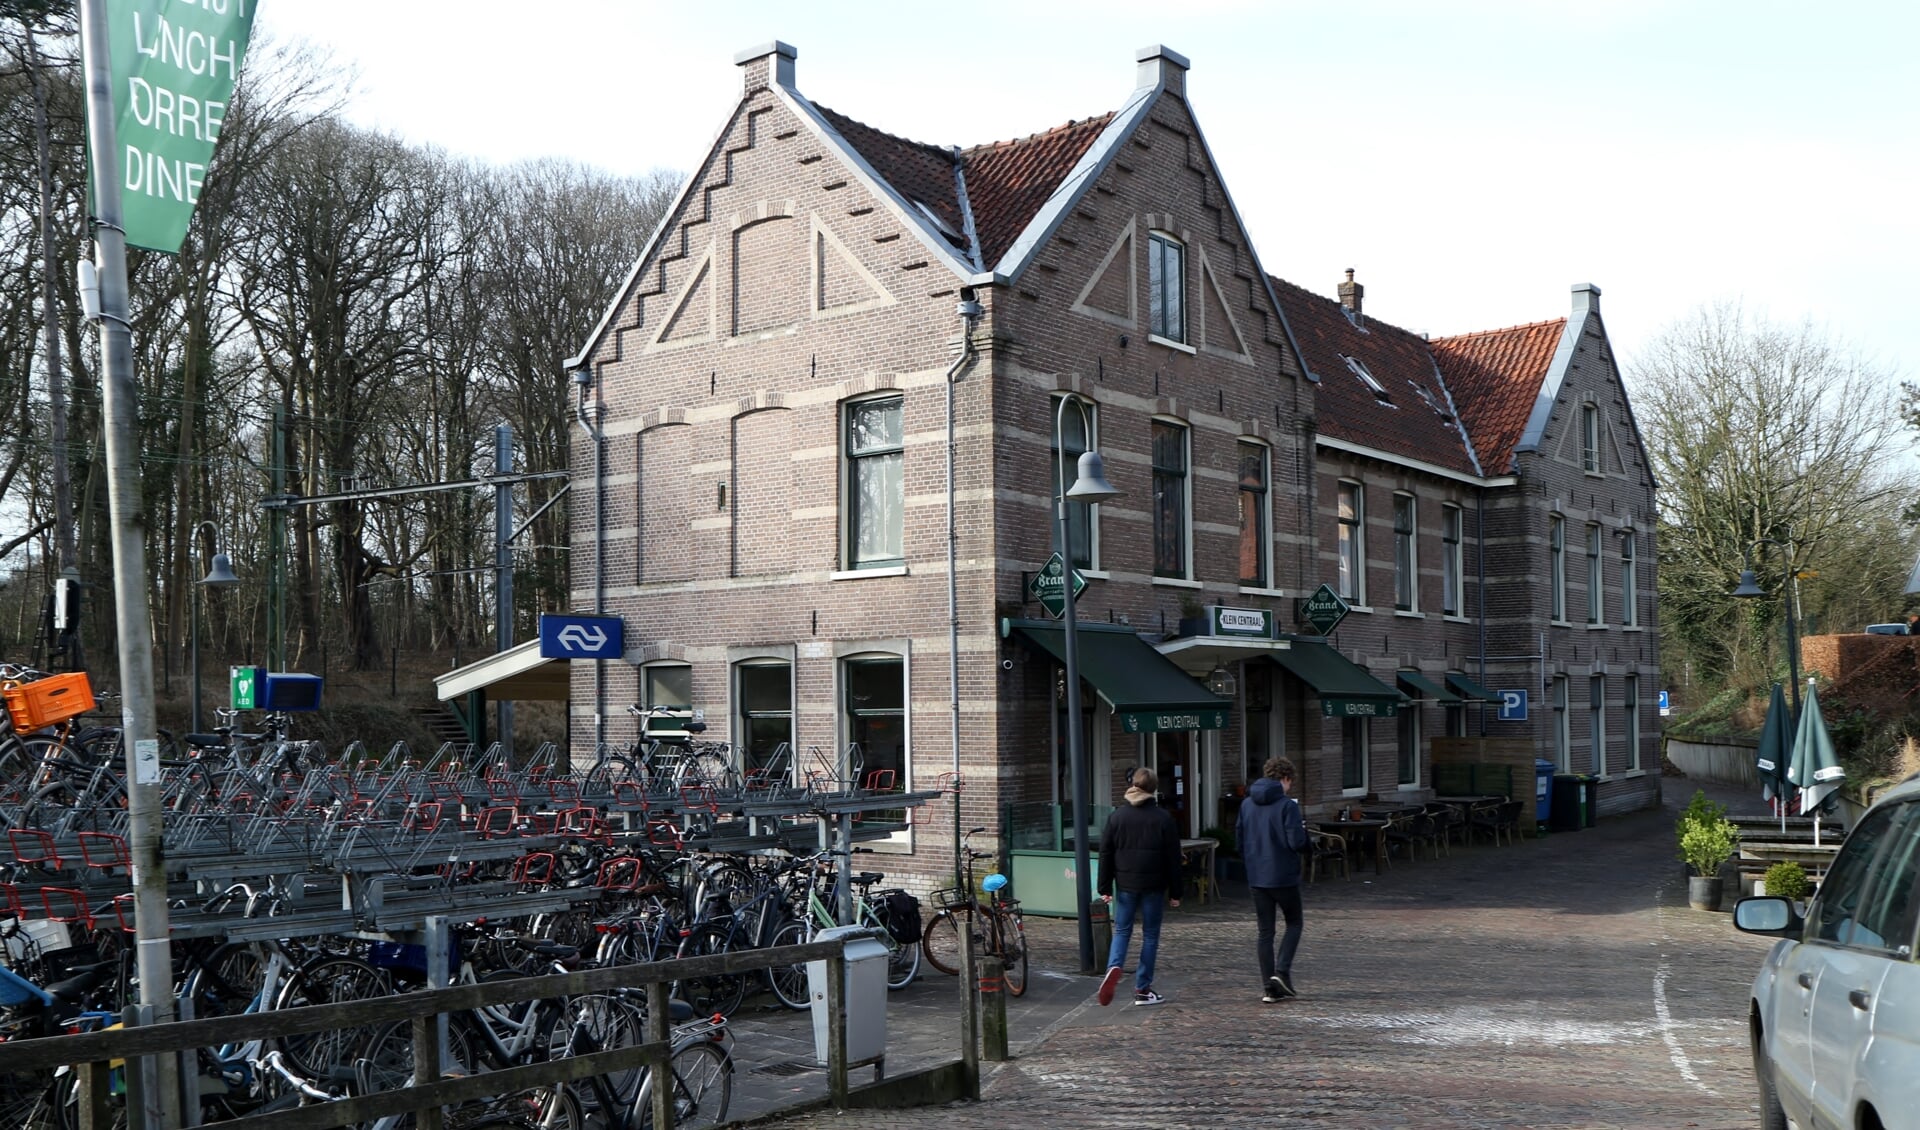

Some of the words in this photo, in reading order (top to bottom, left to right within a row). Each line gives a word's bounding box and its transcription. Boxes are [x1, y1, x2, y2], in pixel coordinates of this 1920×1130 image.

[1038, 573, 1065, 587] Bran
[1308, 600, 1338, 611] Brand
[1223, 614, 1237, 625] KLEIN
[1237, 615, 1262, 627] CENTRAAL
[237, 697, 250, 705] AED
[1503, 692, 1521, 718] P
[1156, 715, 1173, 729] KLEIN
[1173, 715, 1201, 728] CENTRAAL
